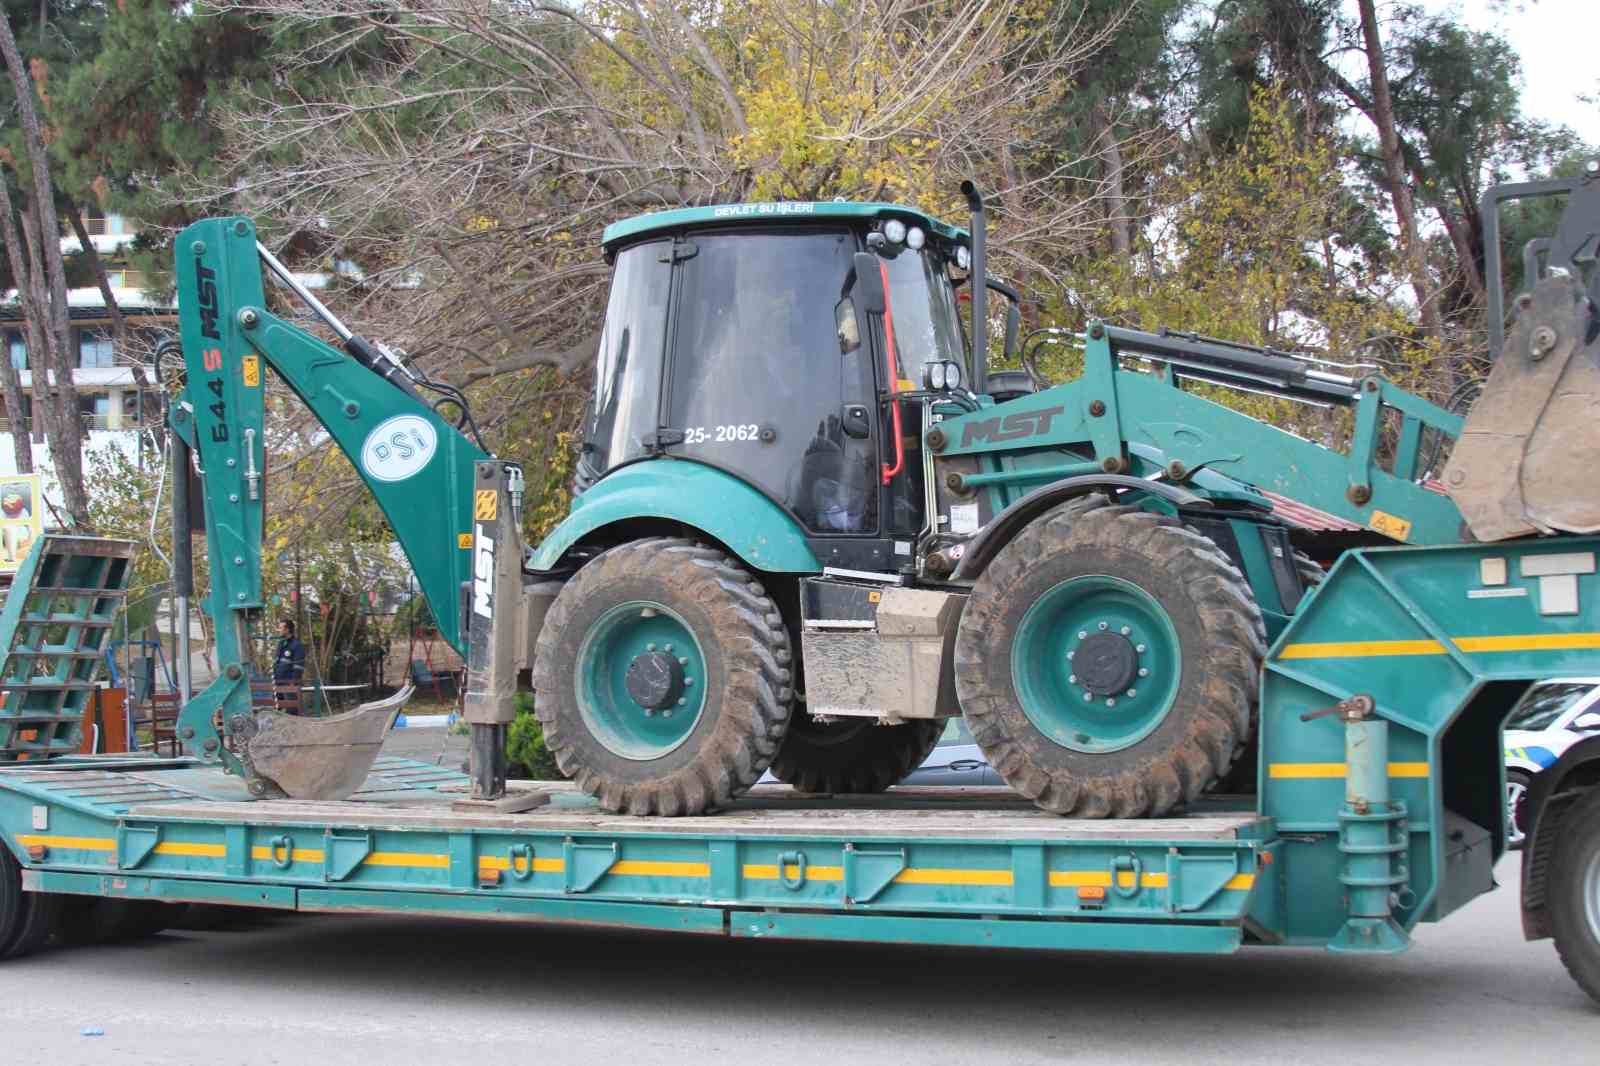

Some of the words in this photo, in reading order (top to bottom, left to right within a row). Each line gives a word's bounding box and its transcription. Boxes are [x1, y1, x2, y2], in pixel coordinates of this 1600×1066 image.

[714, 204, 755, 217] DEVLET
[759, 203, 775, 213] SU
[194, 255, 221, 340] MST
[715, 423, 759, 441] 2062
[960, 405, 1065, 449] MST
[473, 523, 495, 619] MST
